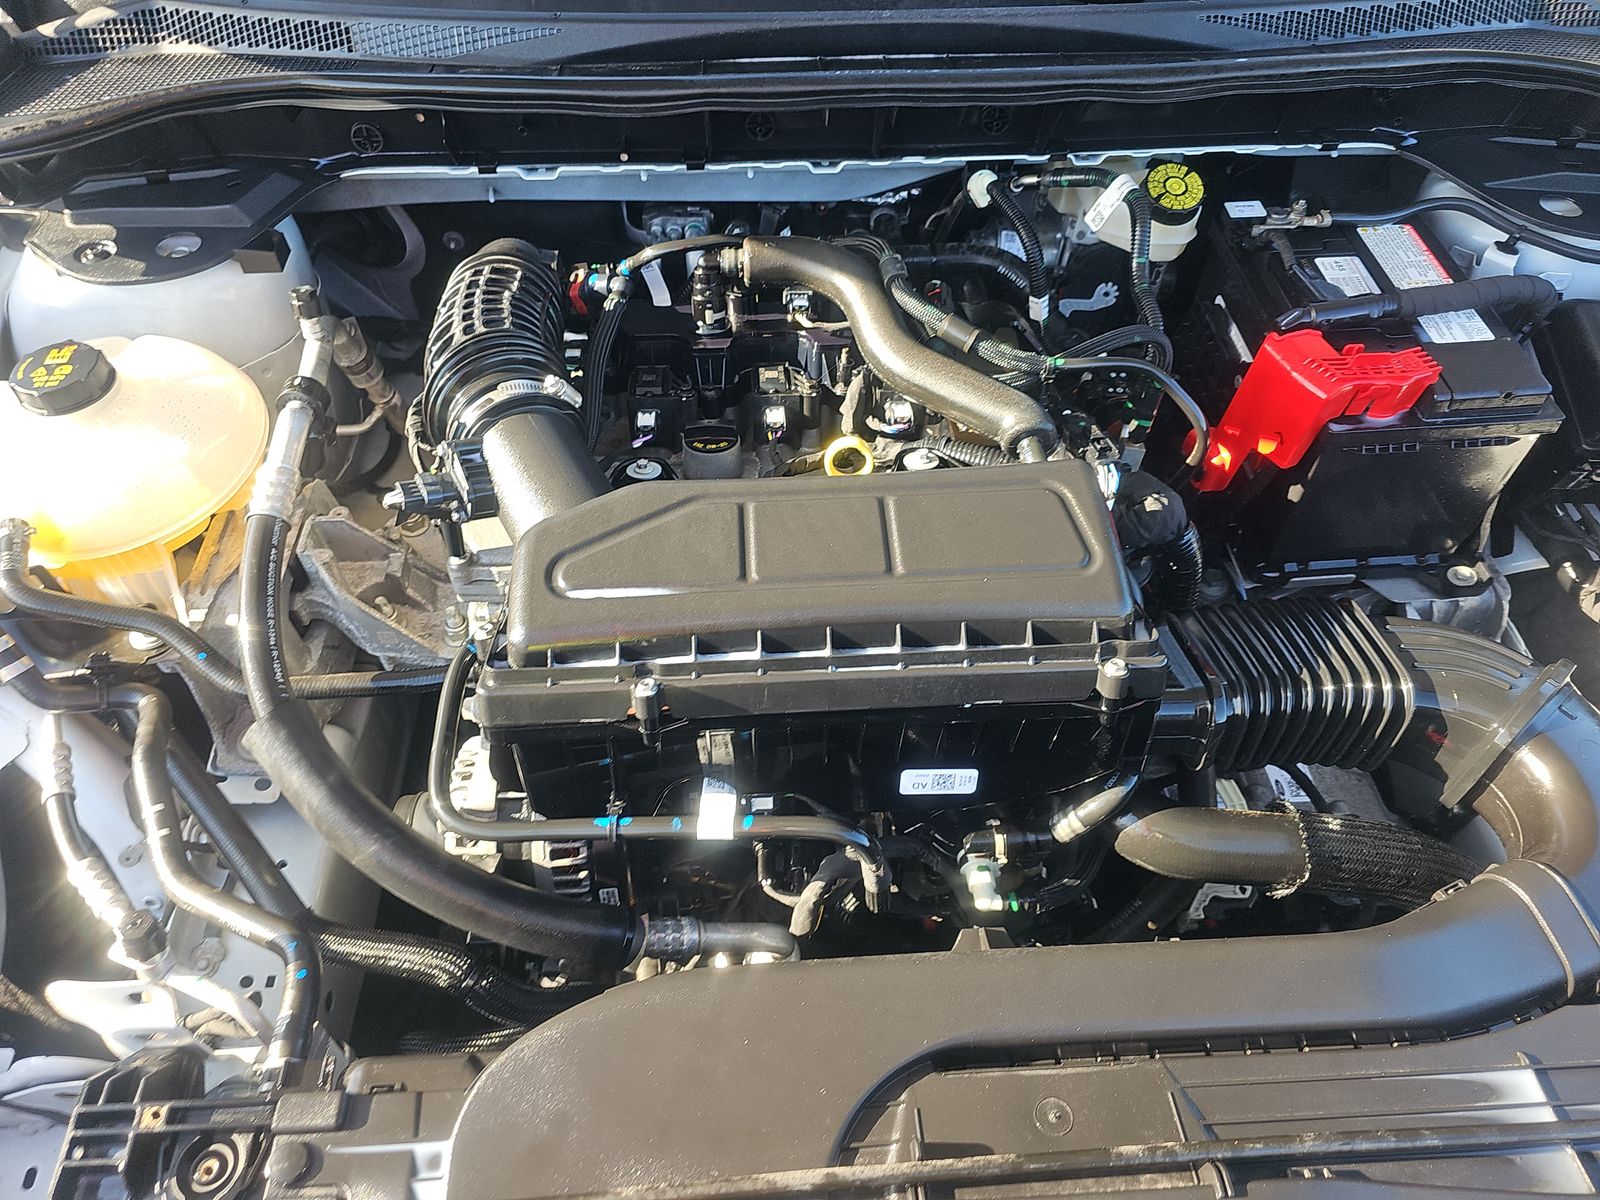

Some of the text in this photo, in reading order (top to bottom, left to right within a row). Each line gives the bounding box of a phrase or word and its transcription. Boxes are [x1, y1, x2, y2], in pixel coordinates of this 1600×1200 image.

[266, 561, 277, 596] SUCTION
[265, 596, 276, 619] HOSE
[912, 781, 928, 790] AD
